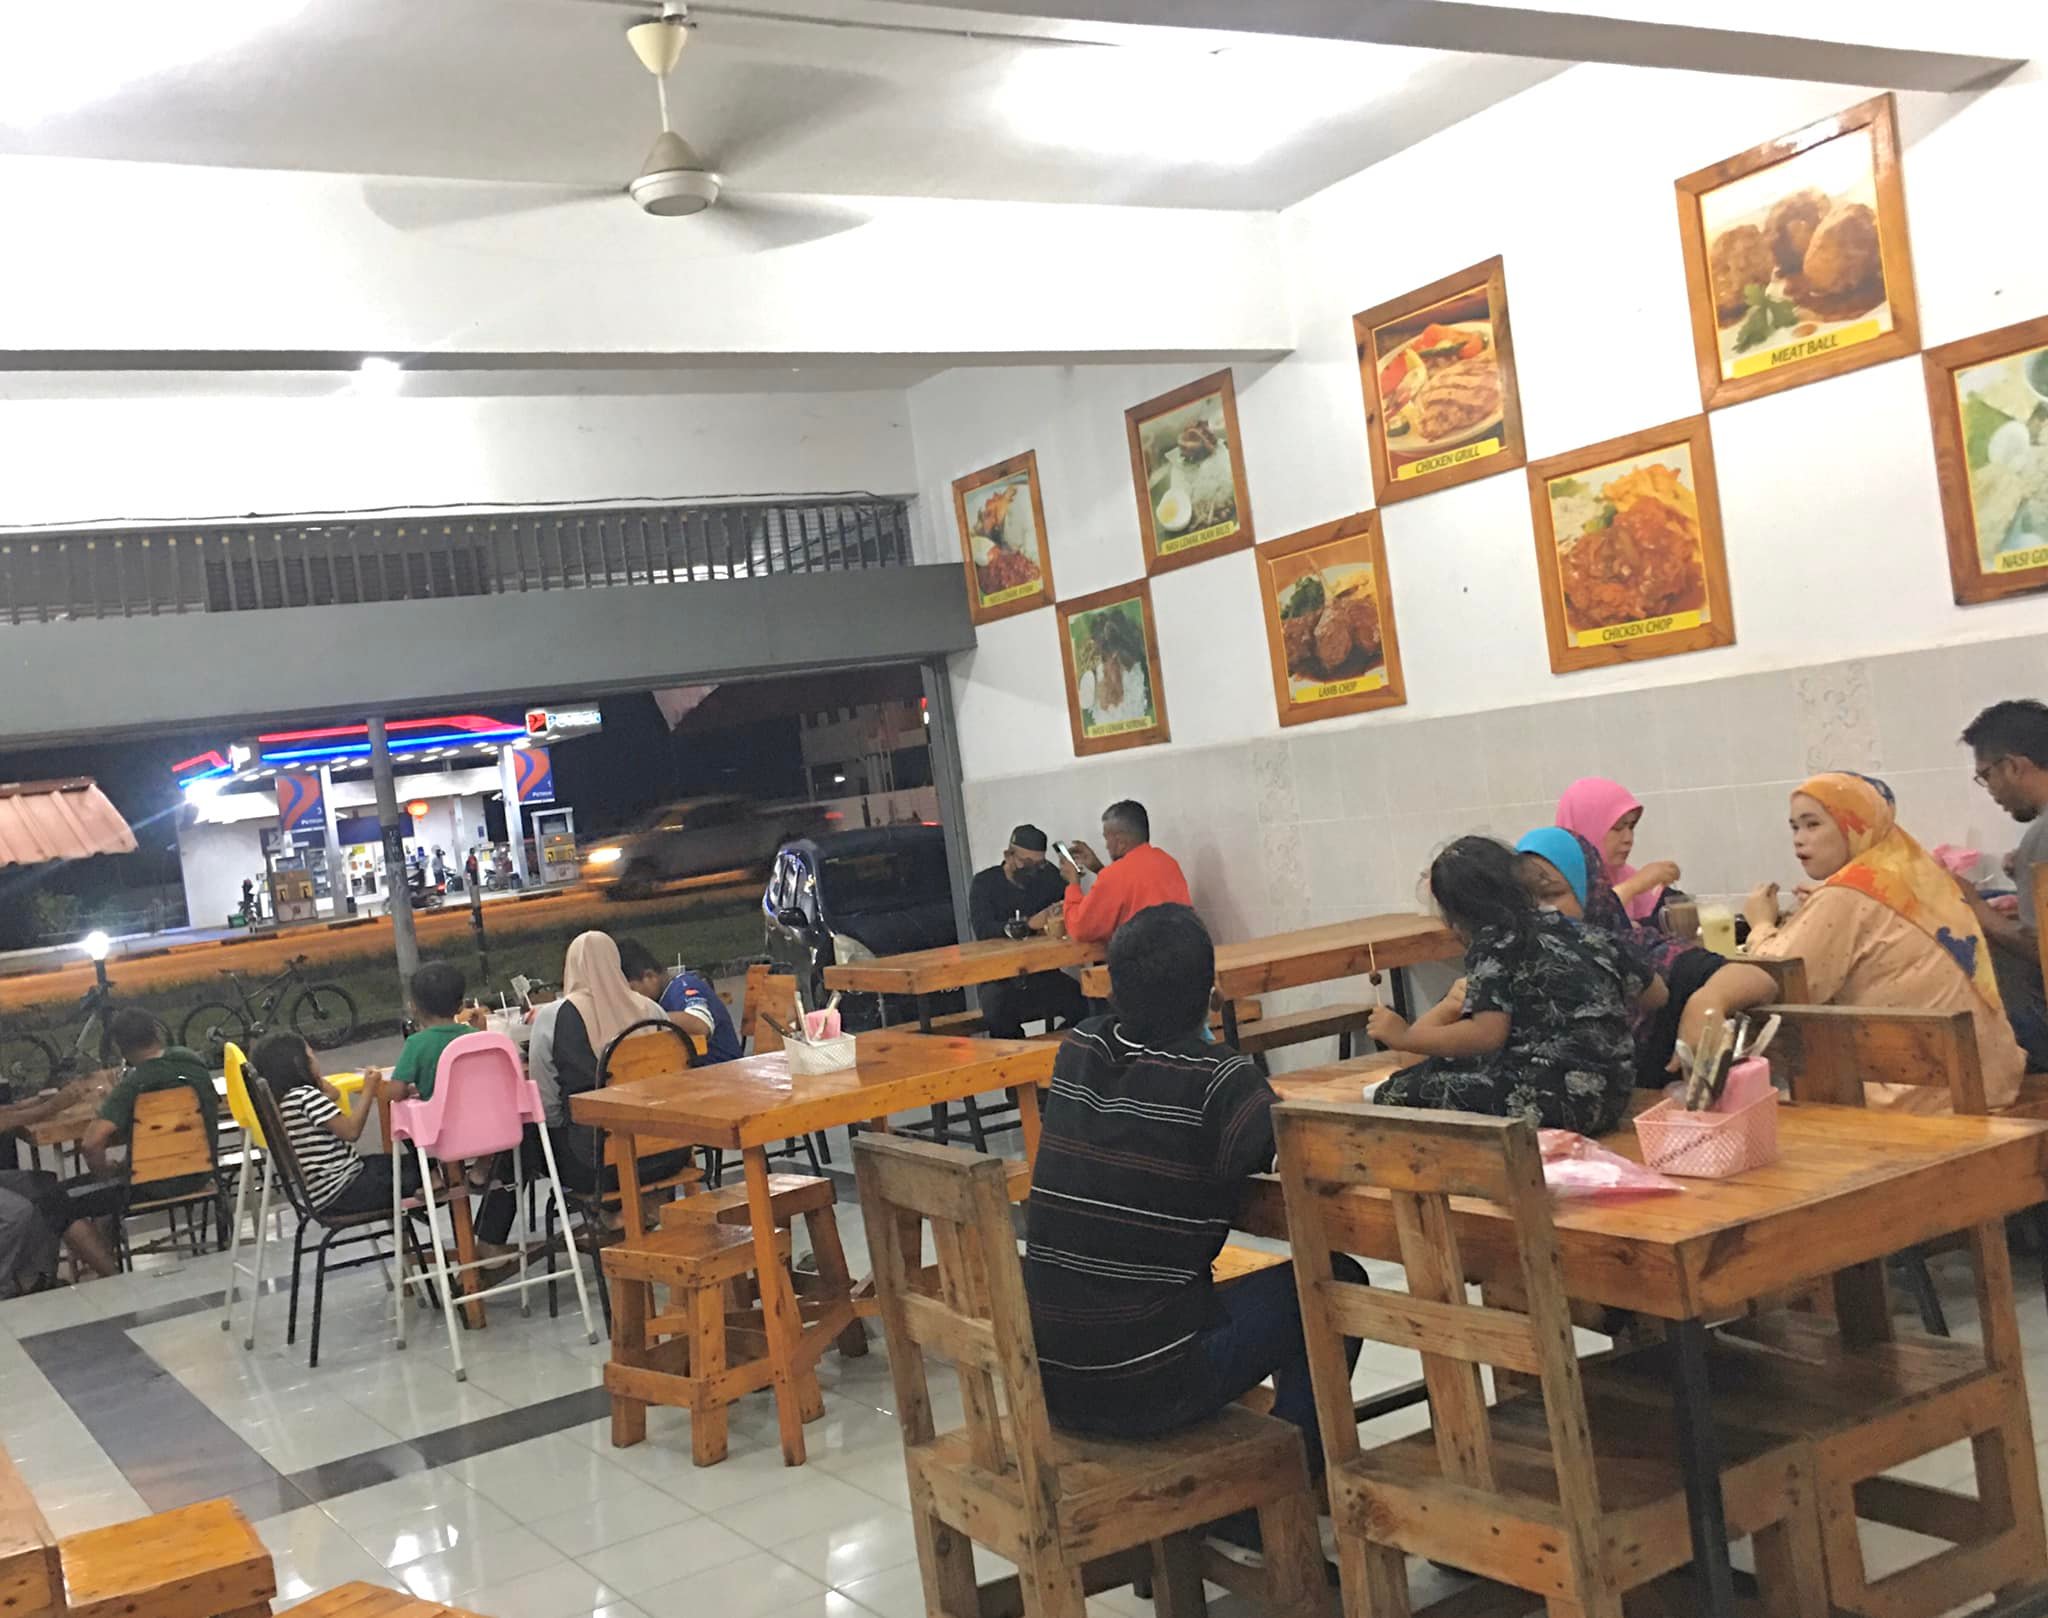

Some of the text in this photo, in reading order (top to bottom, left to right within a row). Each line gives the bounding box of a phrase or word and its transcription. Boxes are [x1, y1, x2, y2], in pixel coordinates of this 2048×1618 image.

[1770, 334, 1839, 365] MEAT BALL
[1415, 455, 1454, 474] CHICKEN
[2002, 550, 2029, 569] NASI
[1602, 617, 1674, 641] CHICKEN CHOP
[1318, 685, 1337, 698] LAMB
